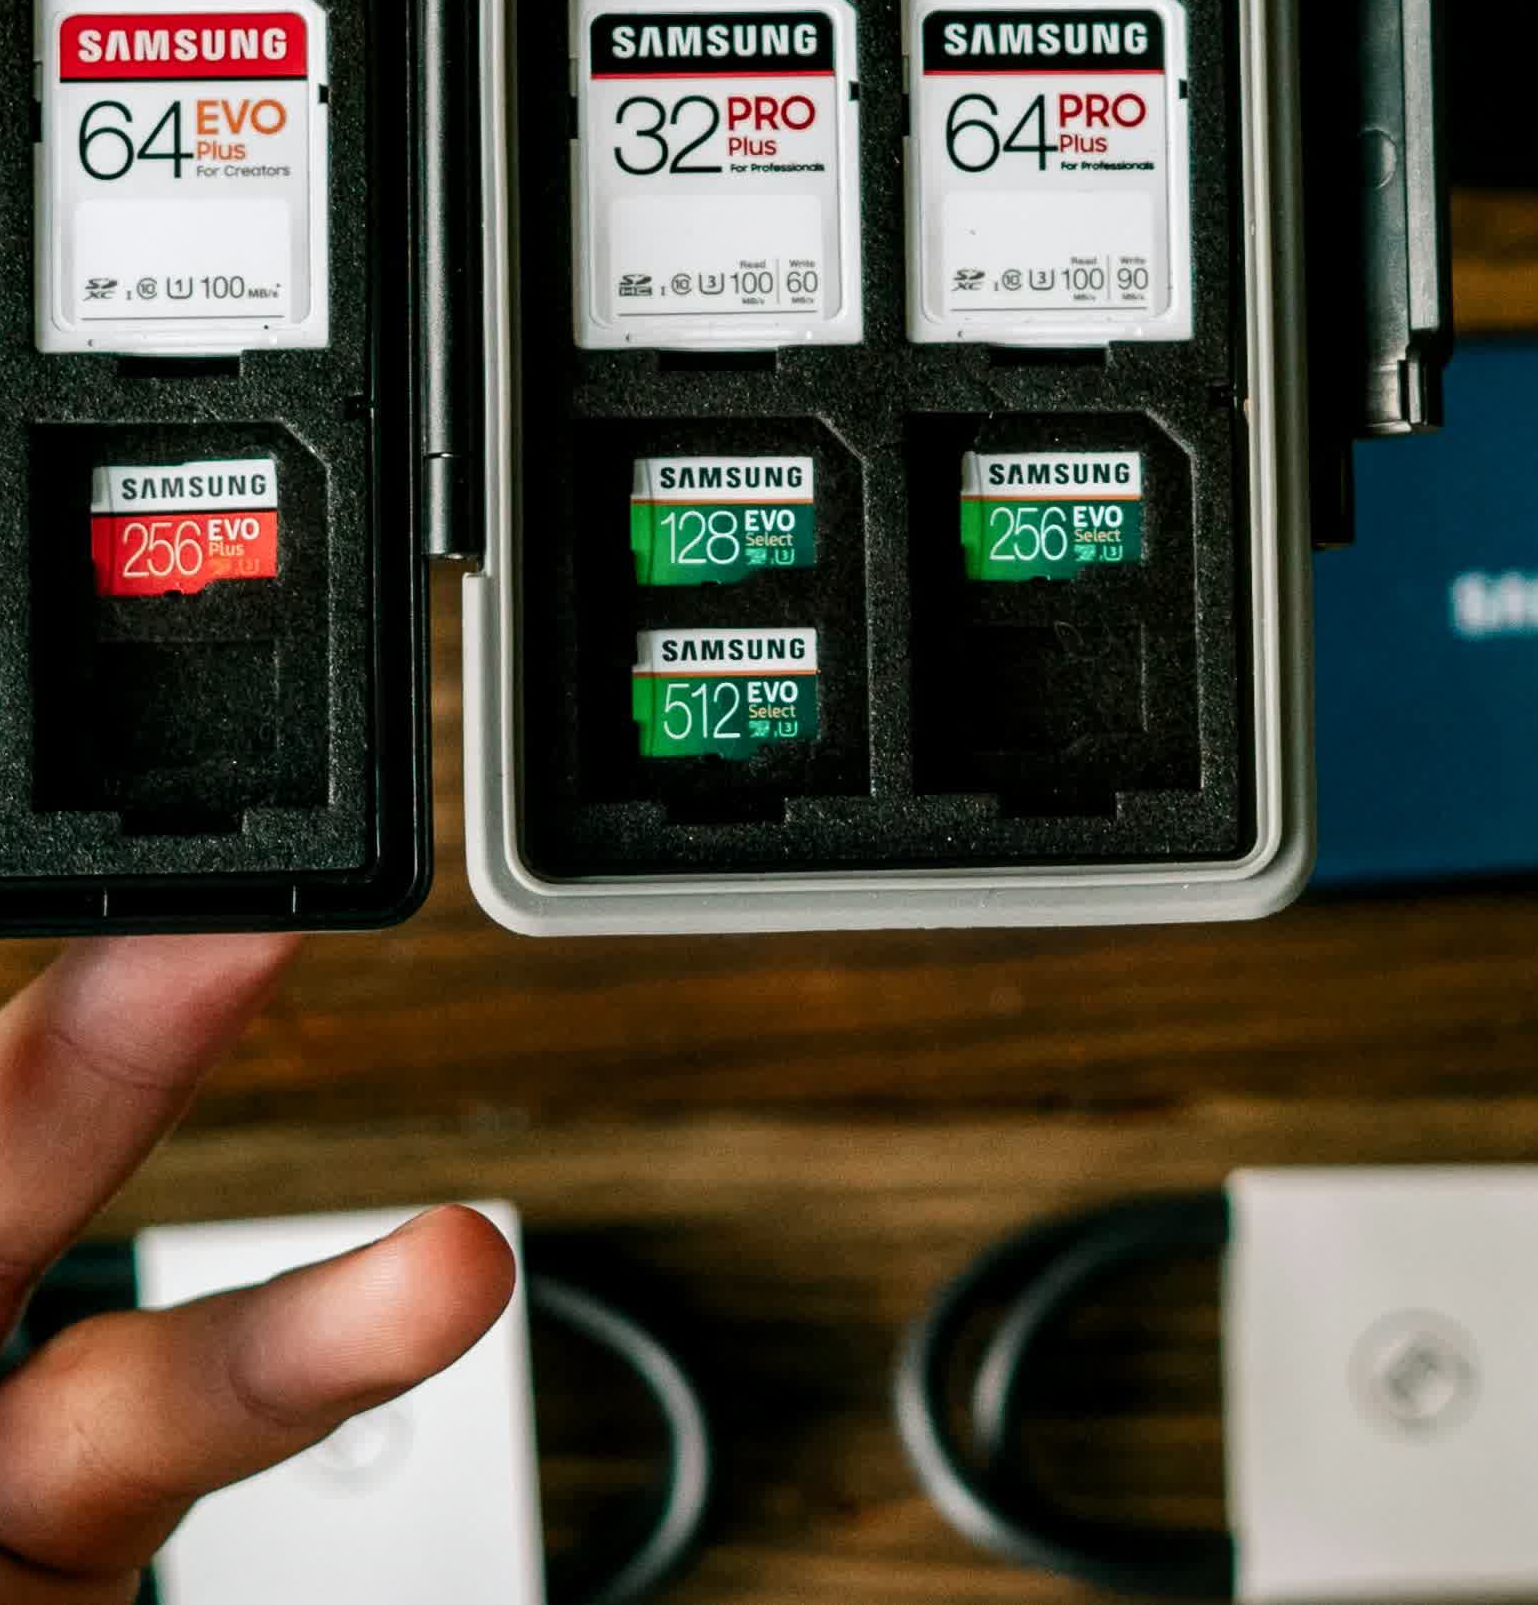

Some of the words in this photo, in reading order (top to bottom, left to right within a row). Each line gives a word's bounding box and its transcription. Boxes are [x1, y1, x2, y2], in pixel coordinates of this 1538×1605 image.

[77, 28, 287, 63] SAMSUNG
[612, 23, 818, 58] SAMSUNG
[944, 23, 1148, 56] SAMSUNG
[79, 101, 193, 180] 64
[196, 99, 286, 135] EVO
[614, 95, 722, 175] 32
[727, 95, 816, 131] PRO
[946, 93, 1058, 172] 64
[1059, 93, 1146, 128] PRO
[1060, 134, 1108, 153] Plus
[196, 141, 246, 161] Plus
[727, 137, 777, 156] Plus
[201, 276, 245, 299] 100
[730, 271, 773, 294] 100
[787, 271, 818, 293] 60
[1061, 268, 1104, 290] 100
[1117, 268, 1149, 290] 90
[660, 467, 802, 488] SAMSUNG
[989, 463, 1130, 485] SAMSUNG
[122, 475, 266, 499] SAMSUNG
[661, 510, 740, 564] 128
[744, 509, 796, 531] EVO
[746, 532, 793, 546] Select
[989, 507, 1068, 561] 256
[1073, 506, 1123, 528] EVO
[1074, 528, 1121, 543] Select
[123, 521, 203, 578] 256
[208, 518, 260, 540] EVO
[209, 541, 244, 556] Plus
[662, 638, 805, 661] SAMSUNG
[663, 682, 741, 740] 512
[748, 681, 799, 703] EVO
[749, 704, 796, 719] Select
